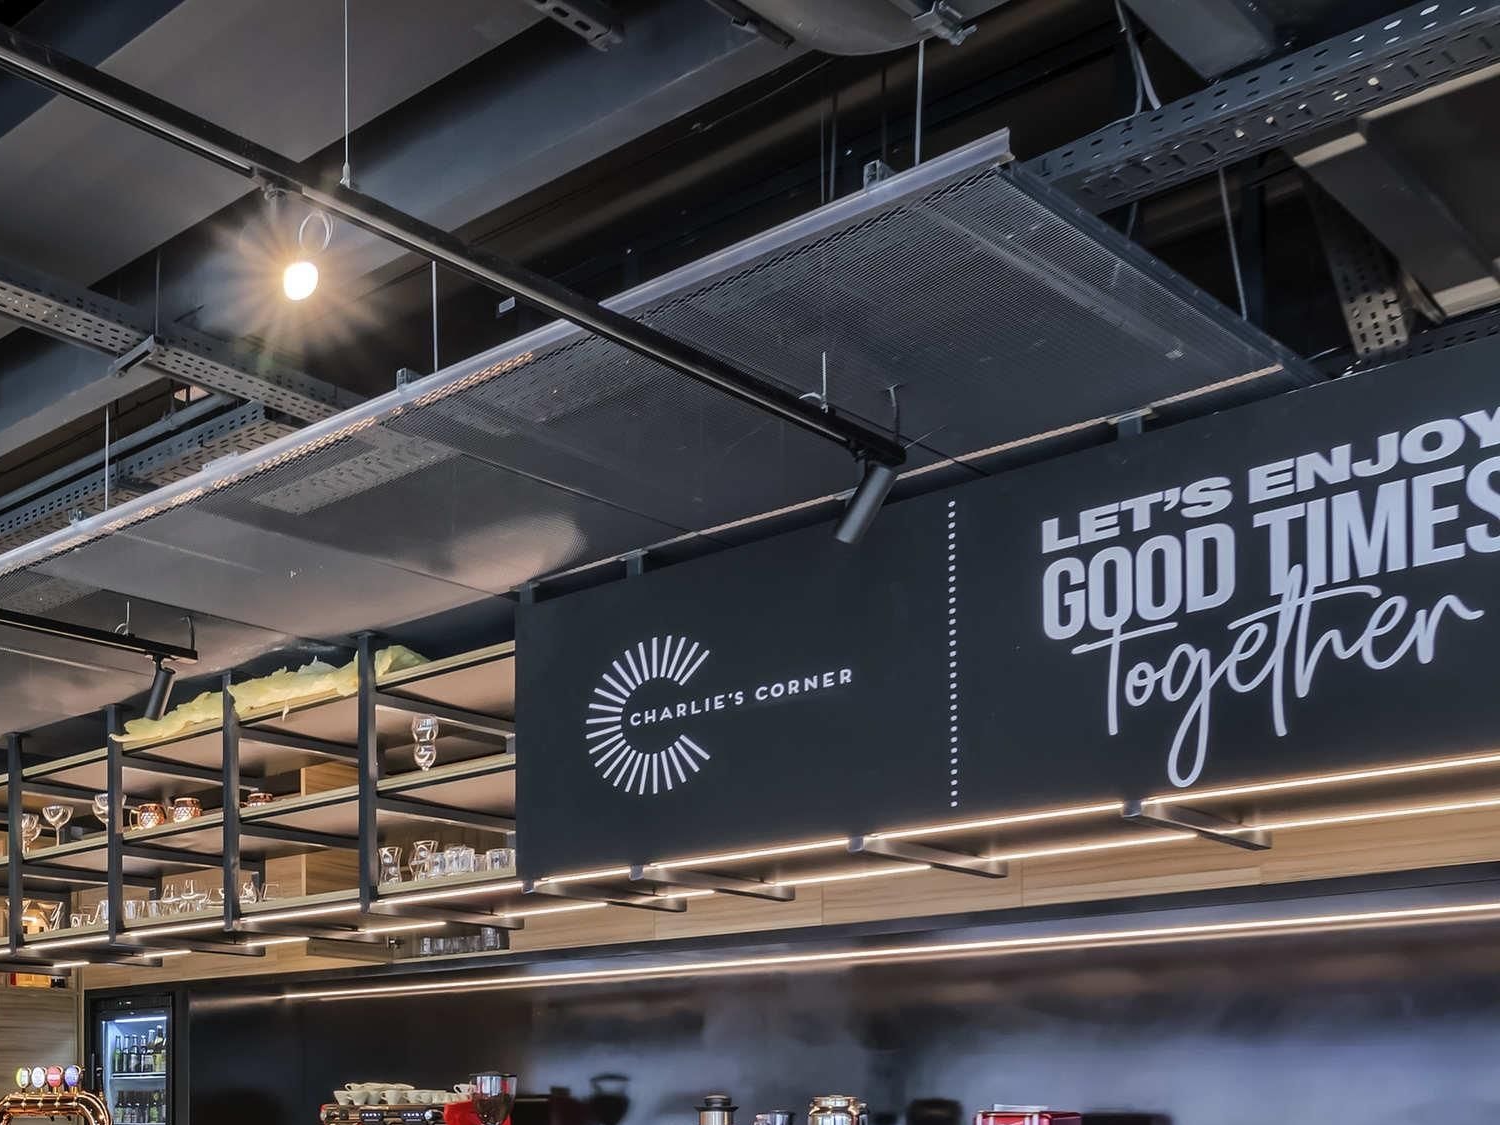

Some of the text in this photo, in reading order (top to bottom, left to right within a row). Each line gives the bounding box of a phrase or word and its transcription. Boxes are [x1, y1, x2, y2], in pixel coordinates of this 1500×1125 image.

[1042, 405, 1500, 554] LET'S ENJOY
[1043, 455, 1500, 640] GOOD TIMES
[628, 667, 853, 728] CHARLIE'S CORNER
[1071, 564, 1485, 788] Together
